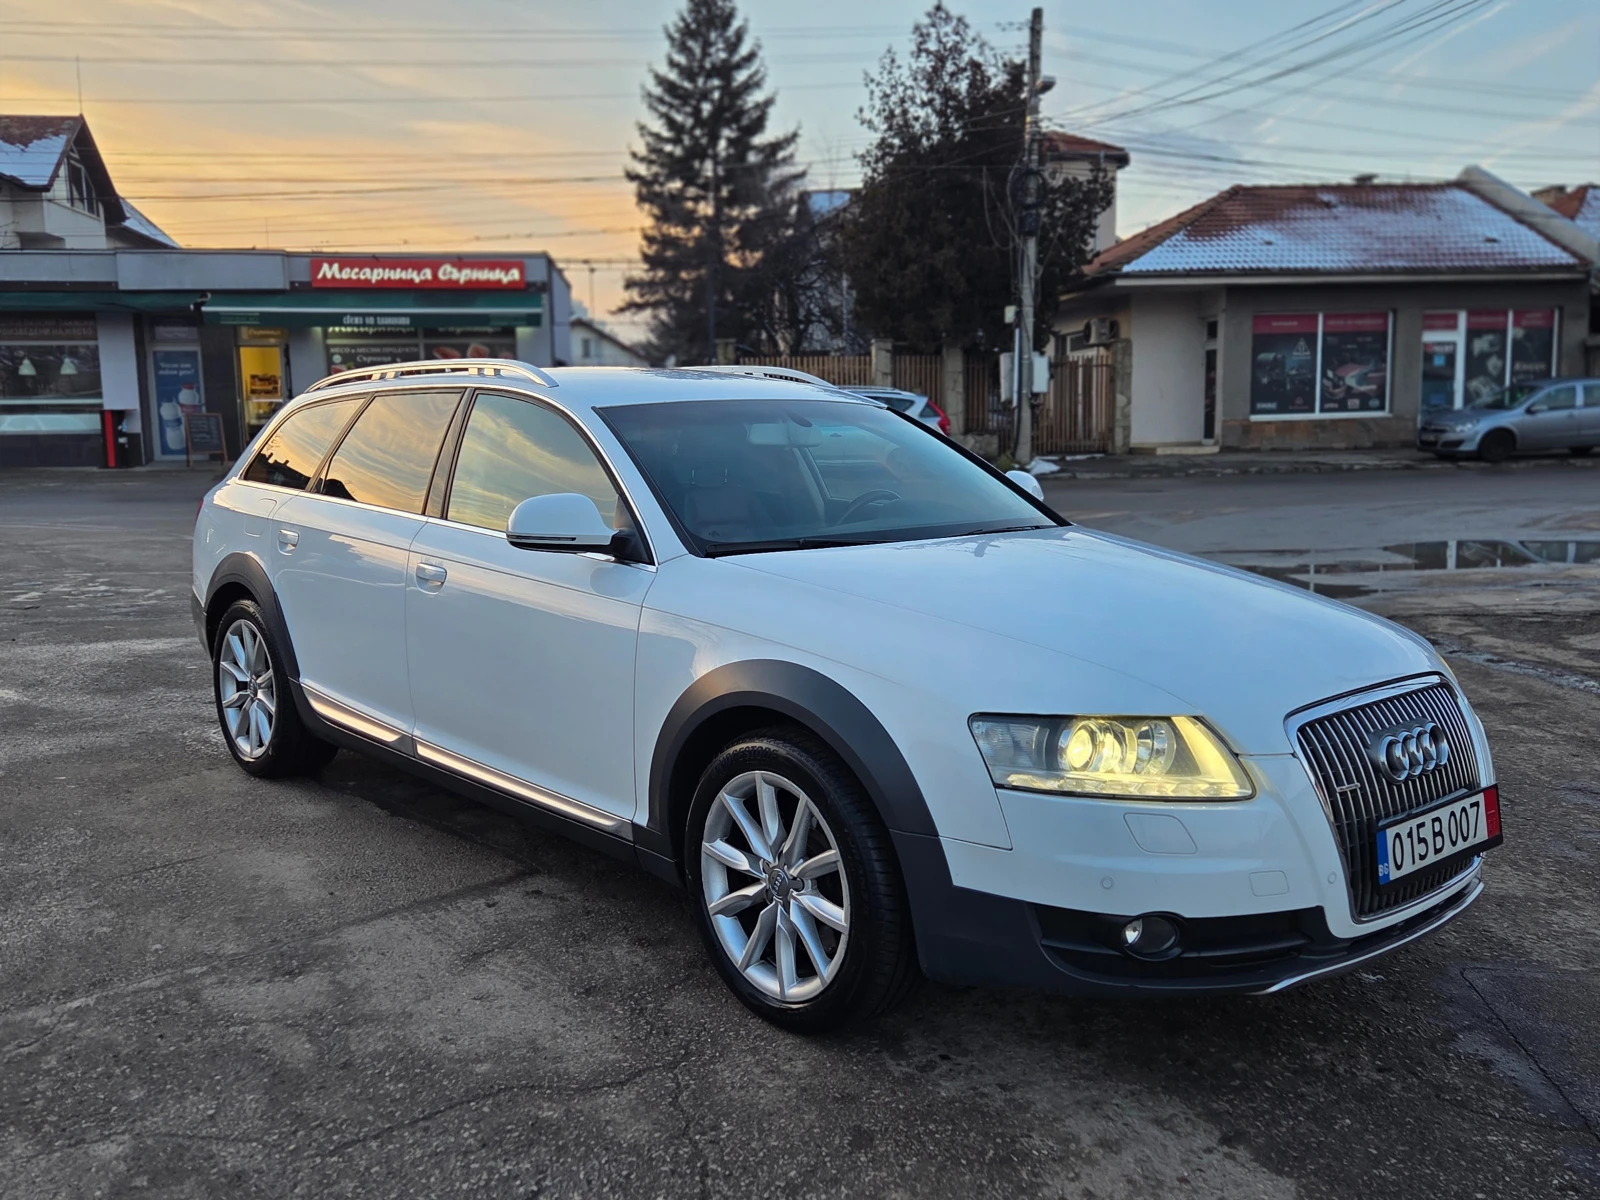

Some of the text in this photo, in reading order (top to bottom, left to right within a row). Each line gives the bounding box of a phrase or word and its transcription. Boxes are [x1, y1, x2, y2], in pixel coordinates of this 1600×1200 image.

[317, 262, 520, 283] Месарница Сърница
[1392, 800, 1480, 871] 015B007
[1378, 862, 1389, 877] BG
